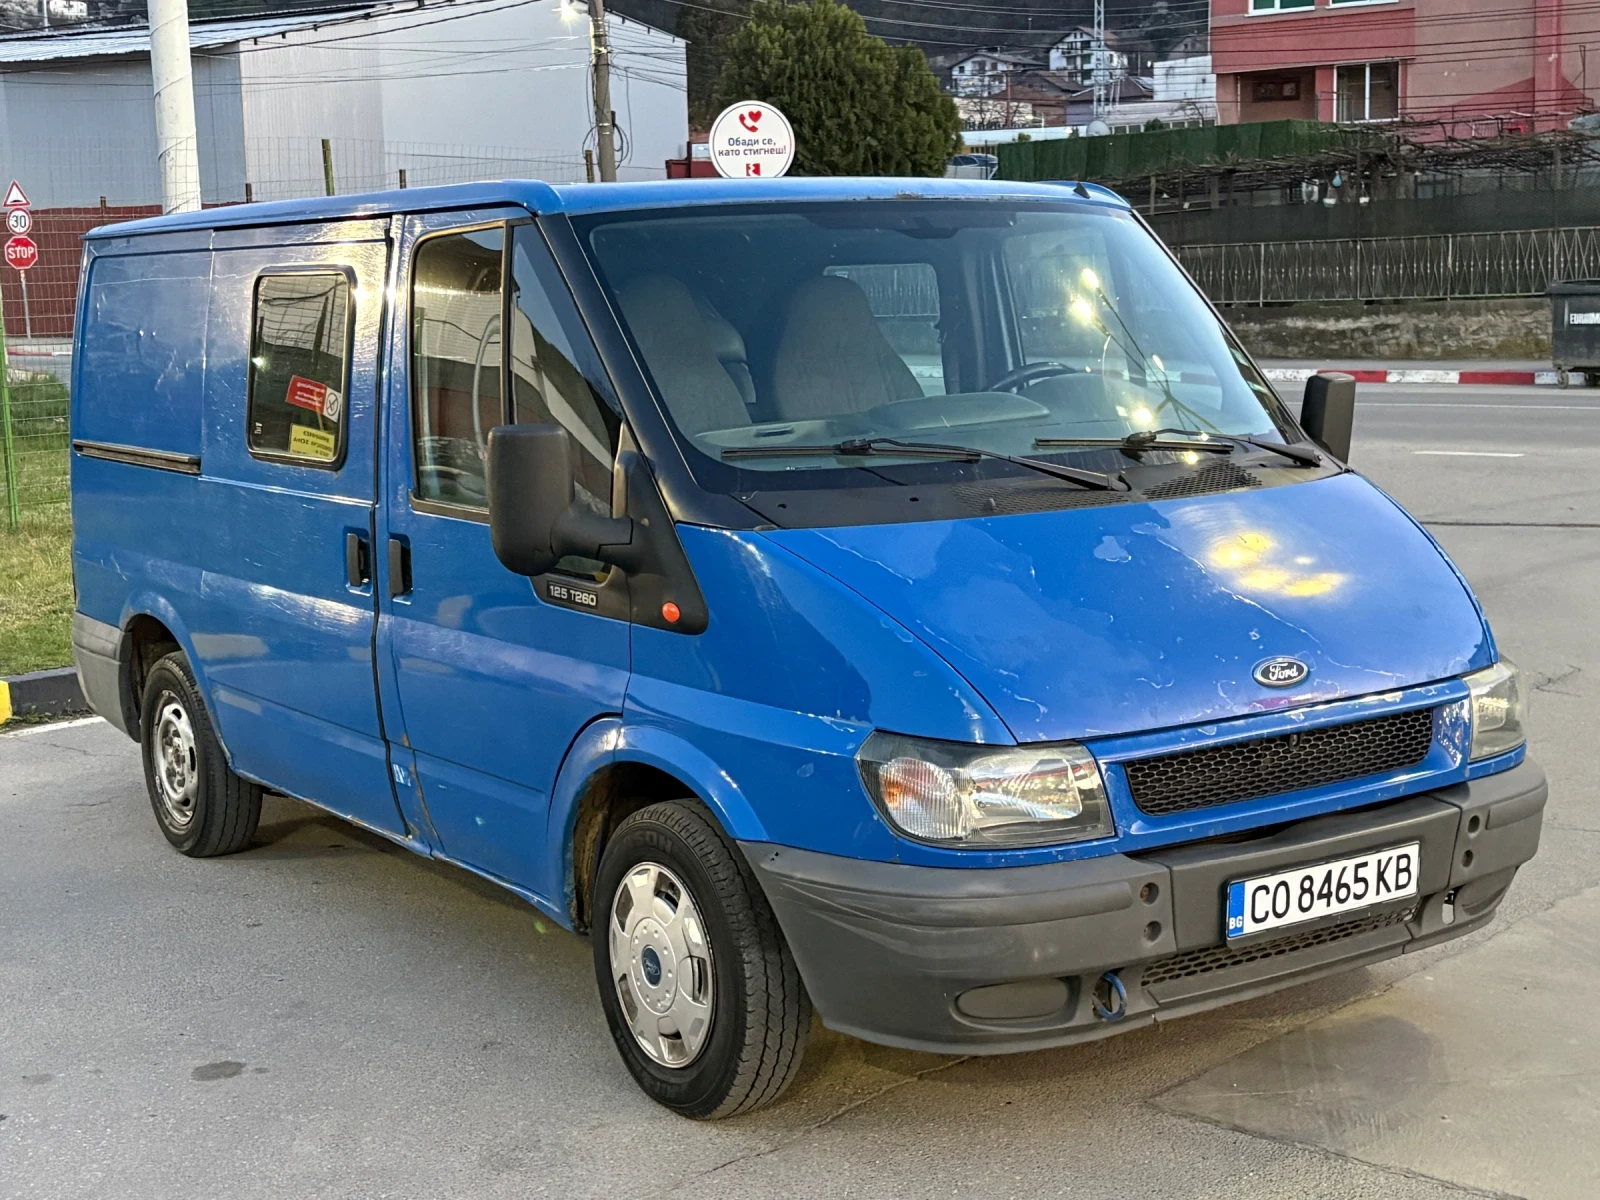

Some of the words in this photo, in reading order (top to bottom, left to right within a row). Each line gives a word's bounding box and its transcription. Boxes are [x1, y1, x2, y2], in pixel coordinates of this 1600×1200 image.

[728, 137, 759, 147] Обади
[762, 138, 776, 146] се,
[718, 149, 741, 157] като
[743, 145, 787, 156] стигнеш!
[11, 214, 27, 228] 30
[8, 246, 34, 259] STOP
[549, 585, 568, 599] 125
[569, 589, 597, 606] T260
[1269, 662, 1299, 680] Ford
[1250, 880, 1291, 924] CO
[1297, 861, 1370, 914] 8465
[1375, 853, 1412, 897] KB
[1229, 916, 1243, 930] BG
